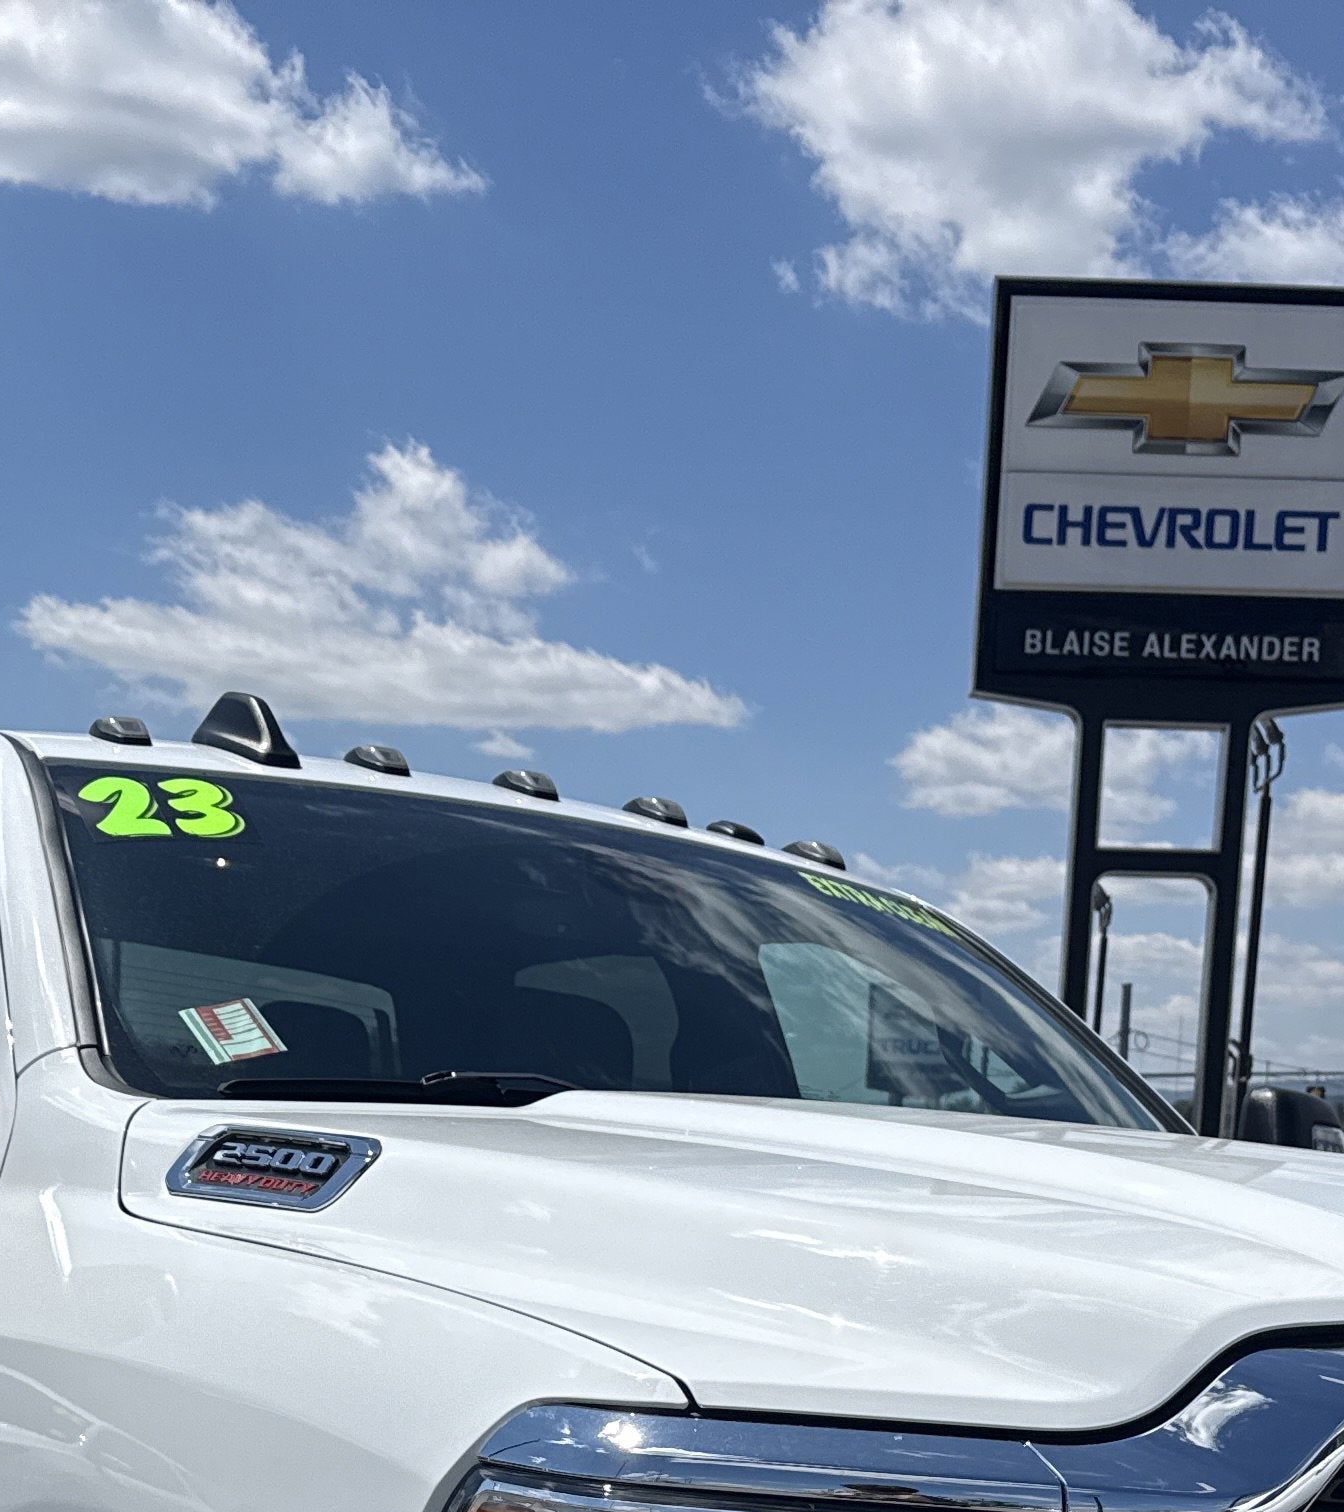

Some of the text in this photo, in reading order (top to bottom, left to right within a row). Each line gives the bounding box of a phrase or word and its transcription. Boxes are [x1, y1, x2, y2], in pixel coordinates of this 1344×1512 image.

[1023, 503, 1341, 553] CHEVROLET
[1024, 628, 1322, 664] BLAISE ALEXANDER
[77, 775, 247, 838] 23
[212, 1141, 337, 1177] 2500
[198, 1170, 319, 1194] HEAVY DUTY
